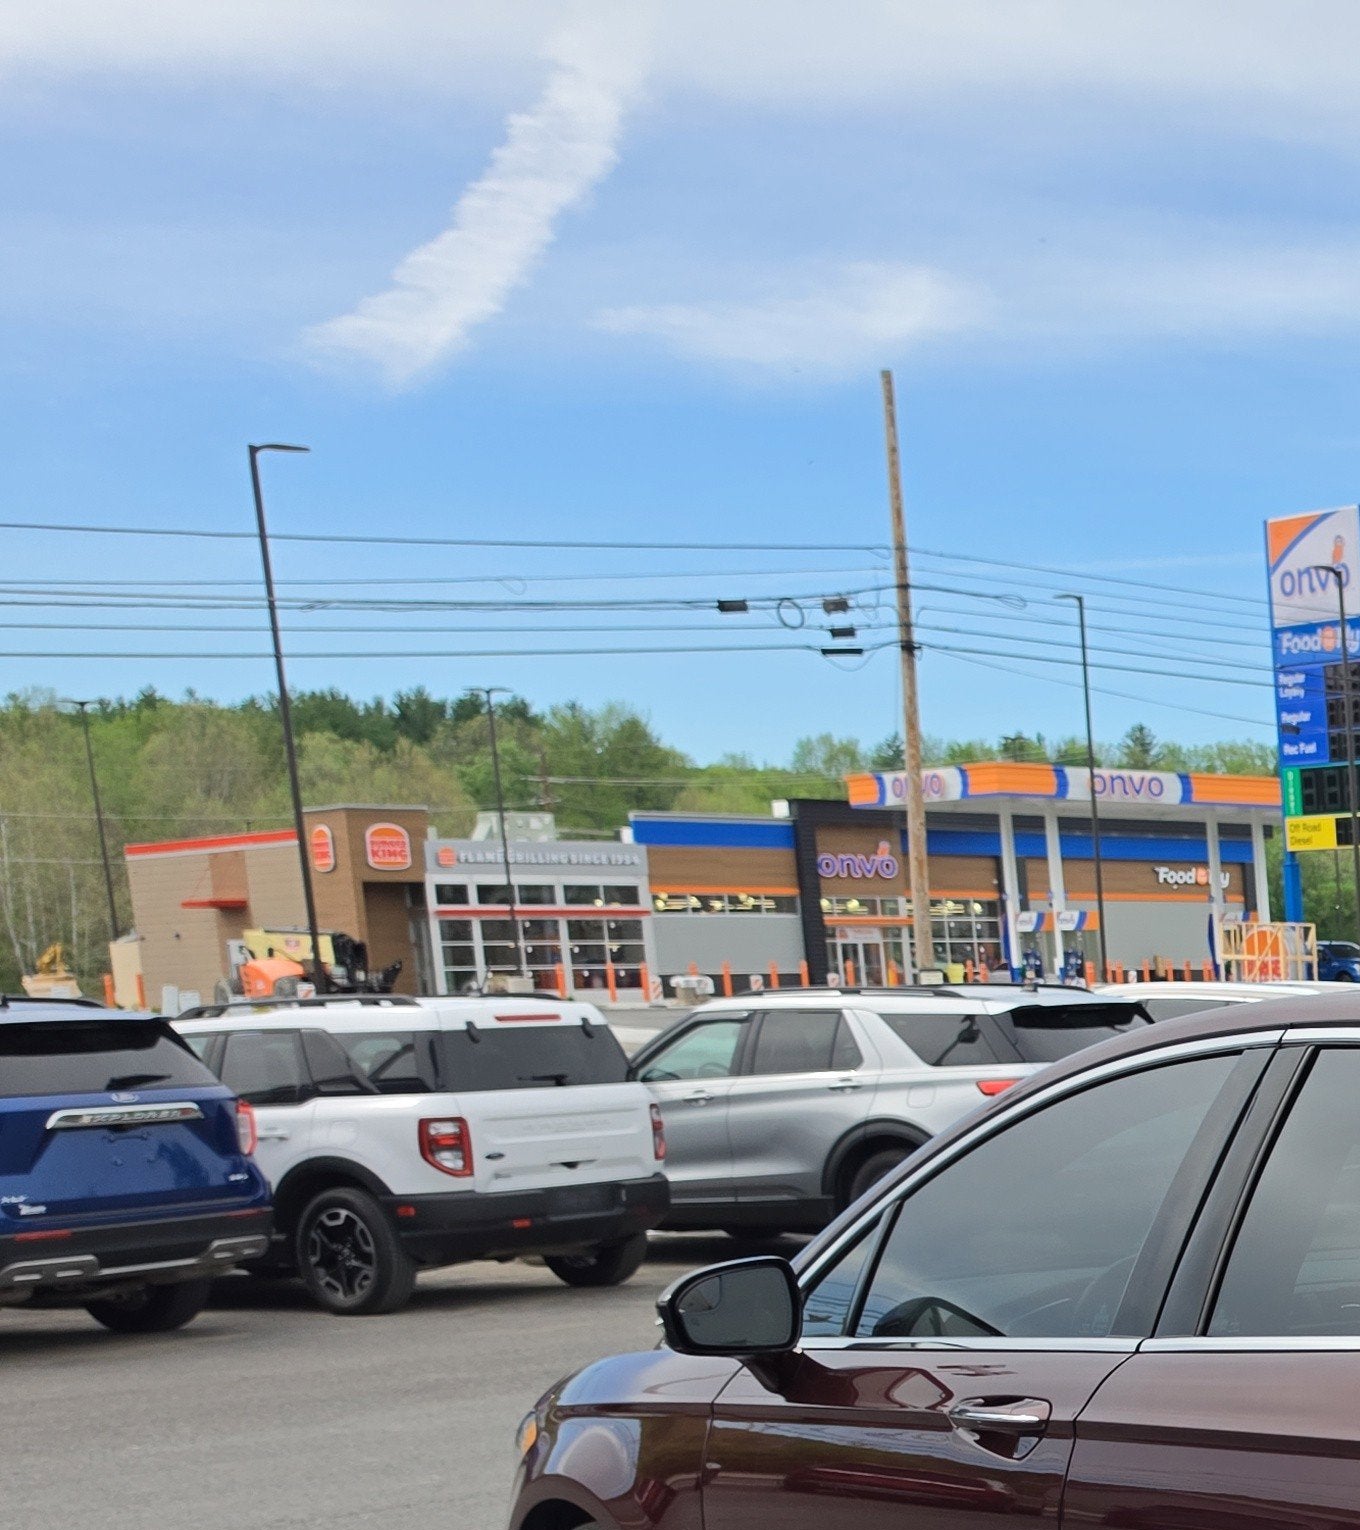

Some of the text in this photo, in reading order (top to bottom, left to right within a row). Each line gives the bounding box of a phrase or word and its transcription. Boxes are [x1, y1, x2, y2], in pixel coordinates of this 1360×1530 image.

[1280, 563, 1350, 597] onvo
[1278, 629, 1321, 654] Food
[1091, 773, 1164, 797] onvo
[370, 849, 408, 860] KING
[818, 853, 898, 879] onvo
[1155, 867, 1196, 884] Food
